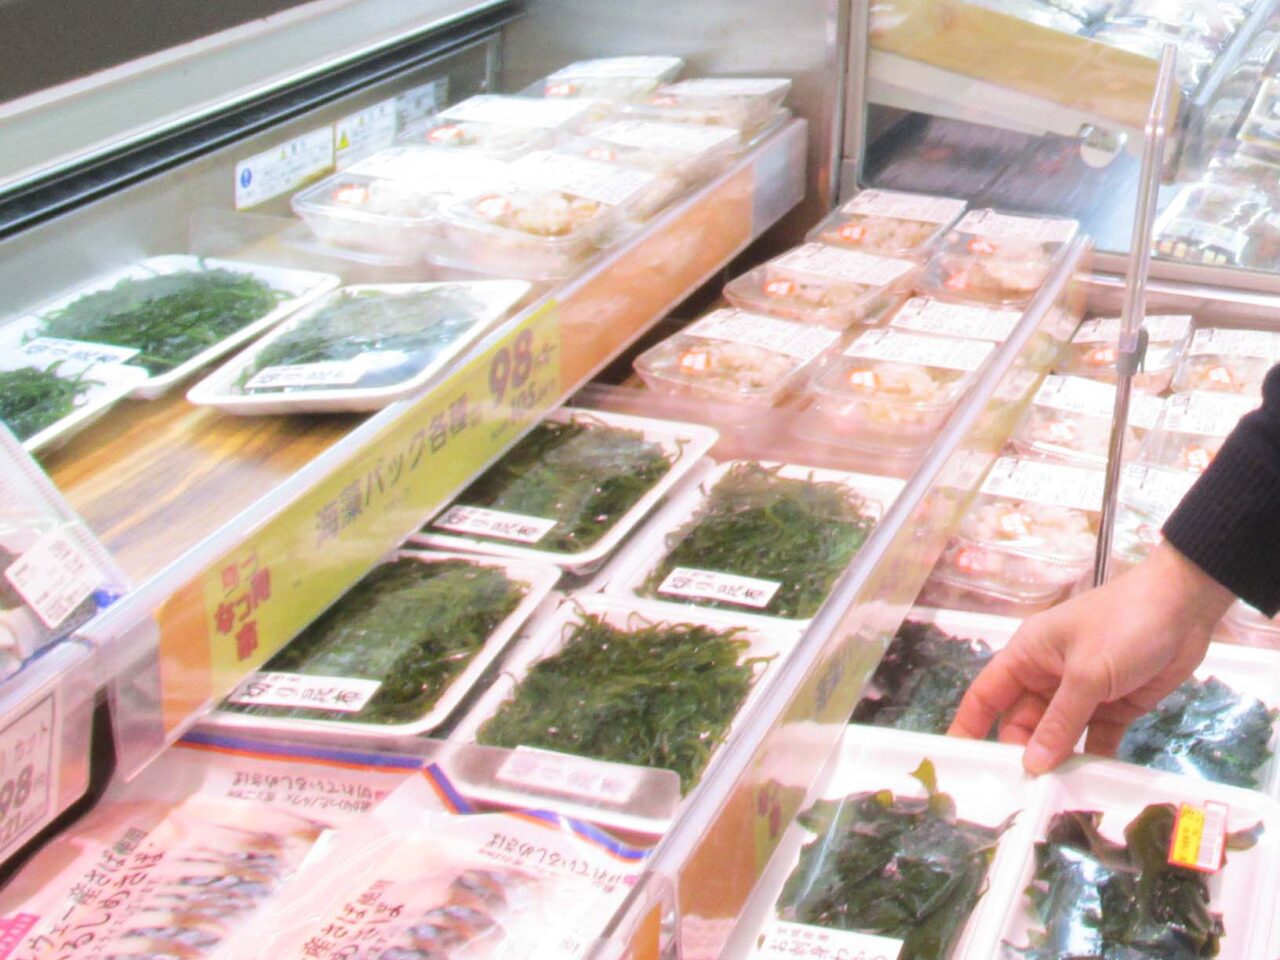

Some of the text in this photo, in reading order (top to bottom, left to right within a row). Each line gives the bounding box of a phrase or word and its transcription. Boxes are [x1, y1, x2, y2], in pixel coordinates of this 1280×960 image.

[15, 827, 148, 960] ウェー産さば使用
